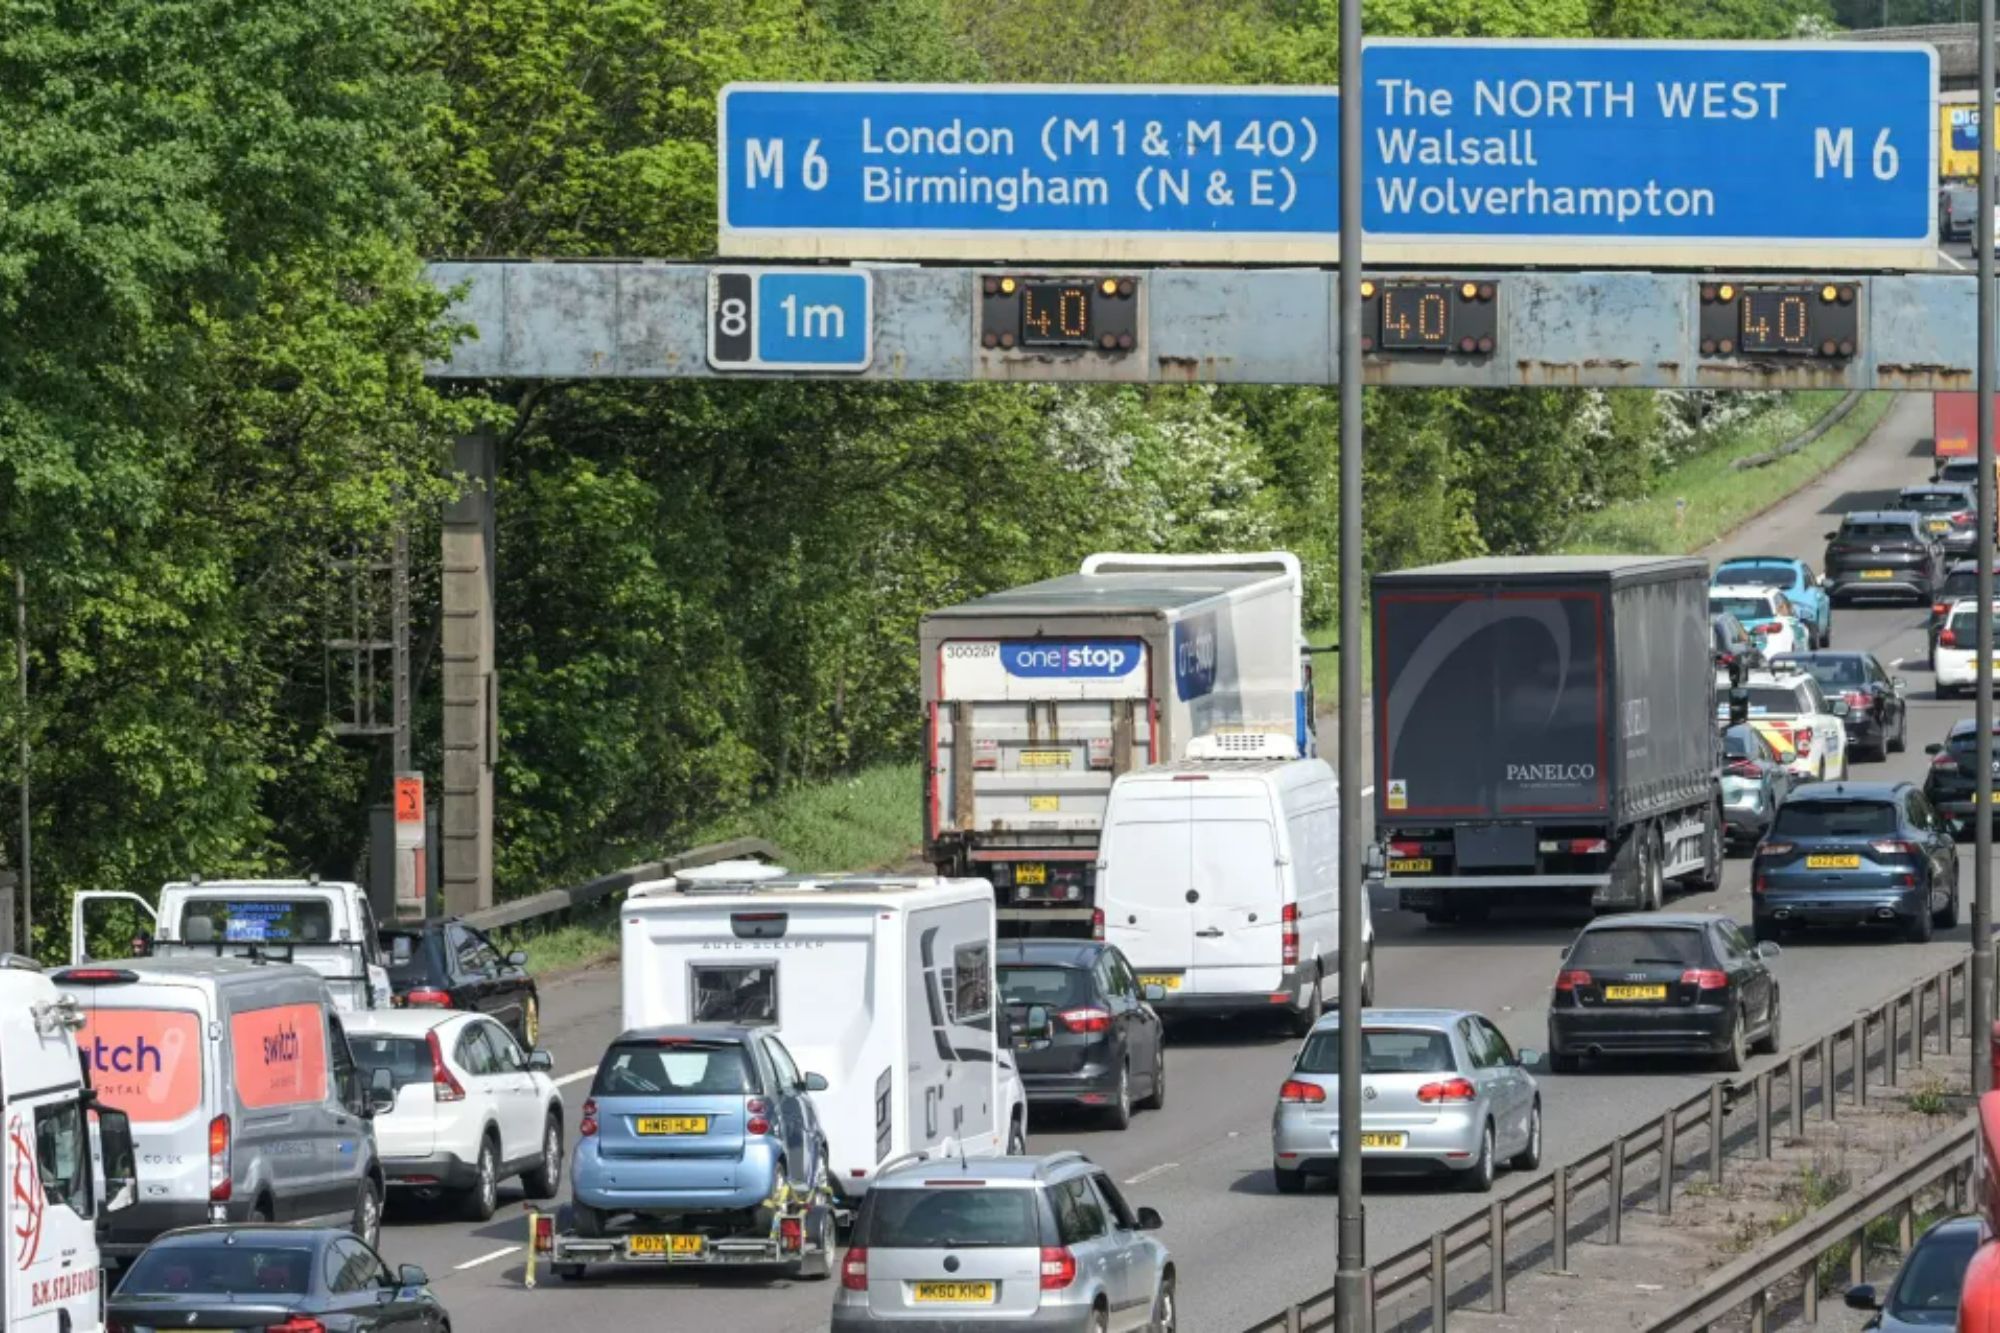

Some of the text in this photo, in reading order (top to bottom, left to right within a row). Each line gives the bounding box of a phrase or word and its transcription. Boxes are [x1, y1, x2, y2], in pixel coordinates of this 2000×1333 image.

[1377, 79, 1787, 119] The NORTH WEST
[863, 117, 1013, 156] London
[1377, 128, 1537, 166] Walsall
[863, 165, 1297, 212] Birmingham (N & E)
[1377, 177, 1715, 223] Wolverhampton
[720, 298, 747, 337] 8
[780, 293, 845, 338] 1m
[1026, 290, 1085, 336] 40
[1385, 293, 1445, 339] 40
[1744, 296, 1805, 342] 40
[946, 645, 997, 659] 300287
[1506, 763, 1595, 781] PANELCO
